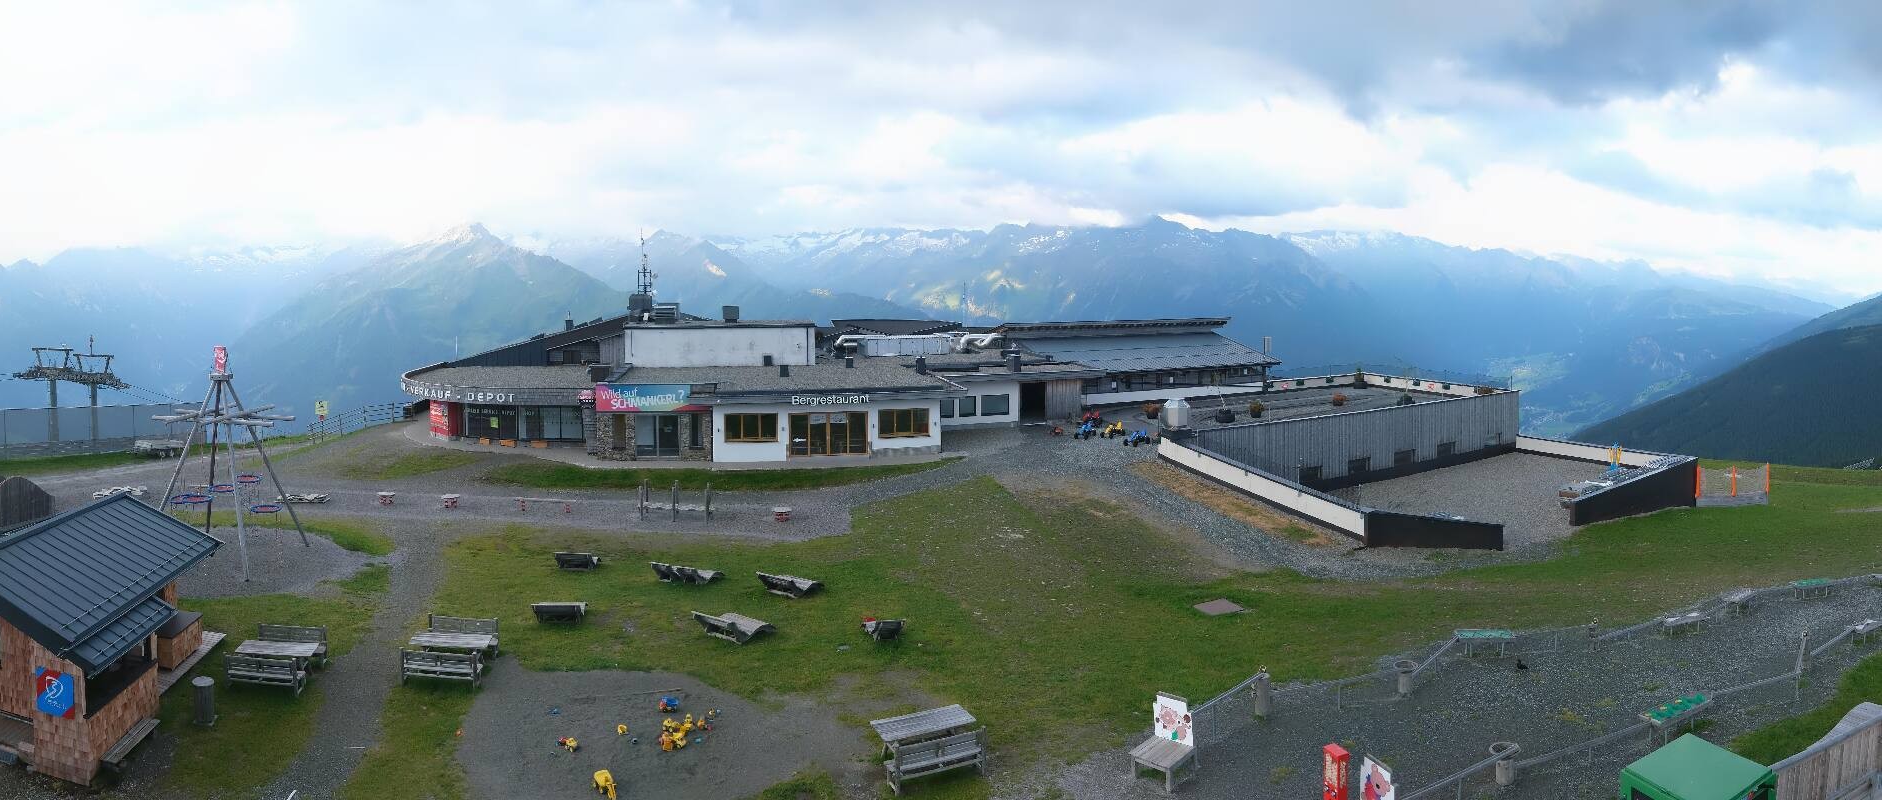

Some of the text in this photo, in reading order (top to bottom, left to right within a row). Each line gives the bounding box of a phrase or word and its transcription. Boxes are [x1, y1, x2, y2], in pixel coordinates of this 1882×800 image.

[410, 385, 451, 399] VERKAUF
[467, 392, 515, 403] DEPOT
[600, 387, 638, 400] Wild auf
[791, 394, 870, 406] Bergrestaurant
